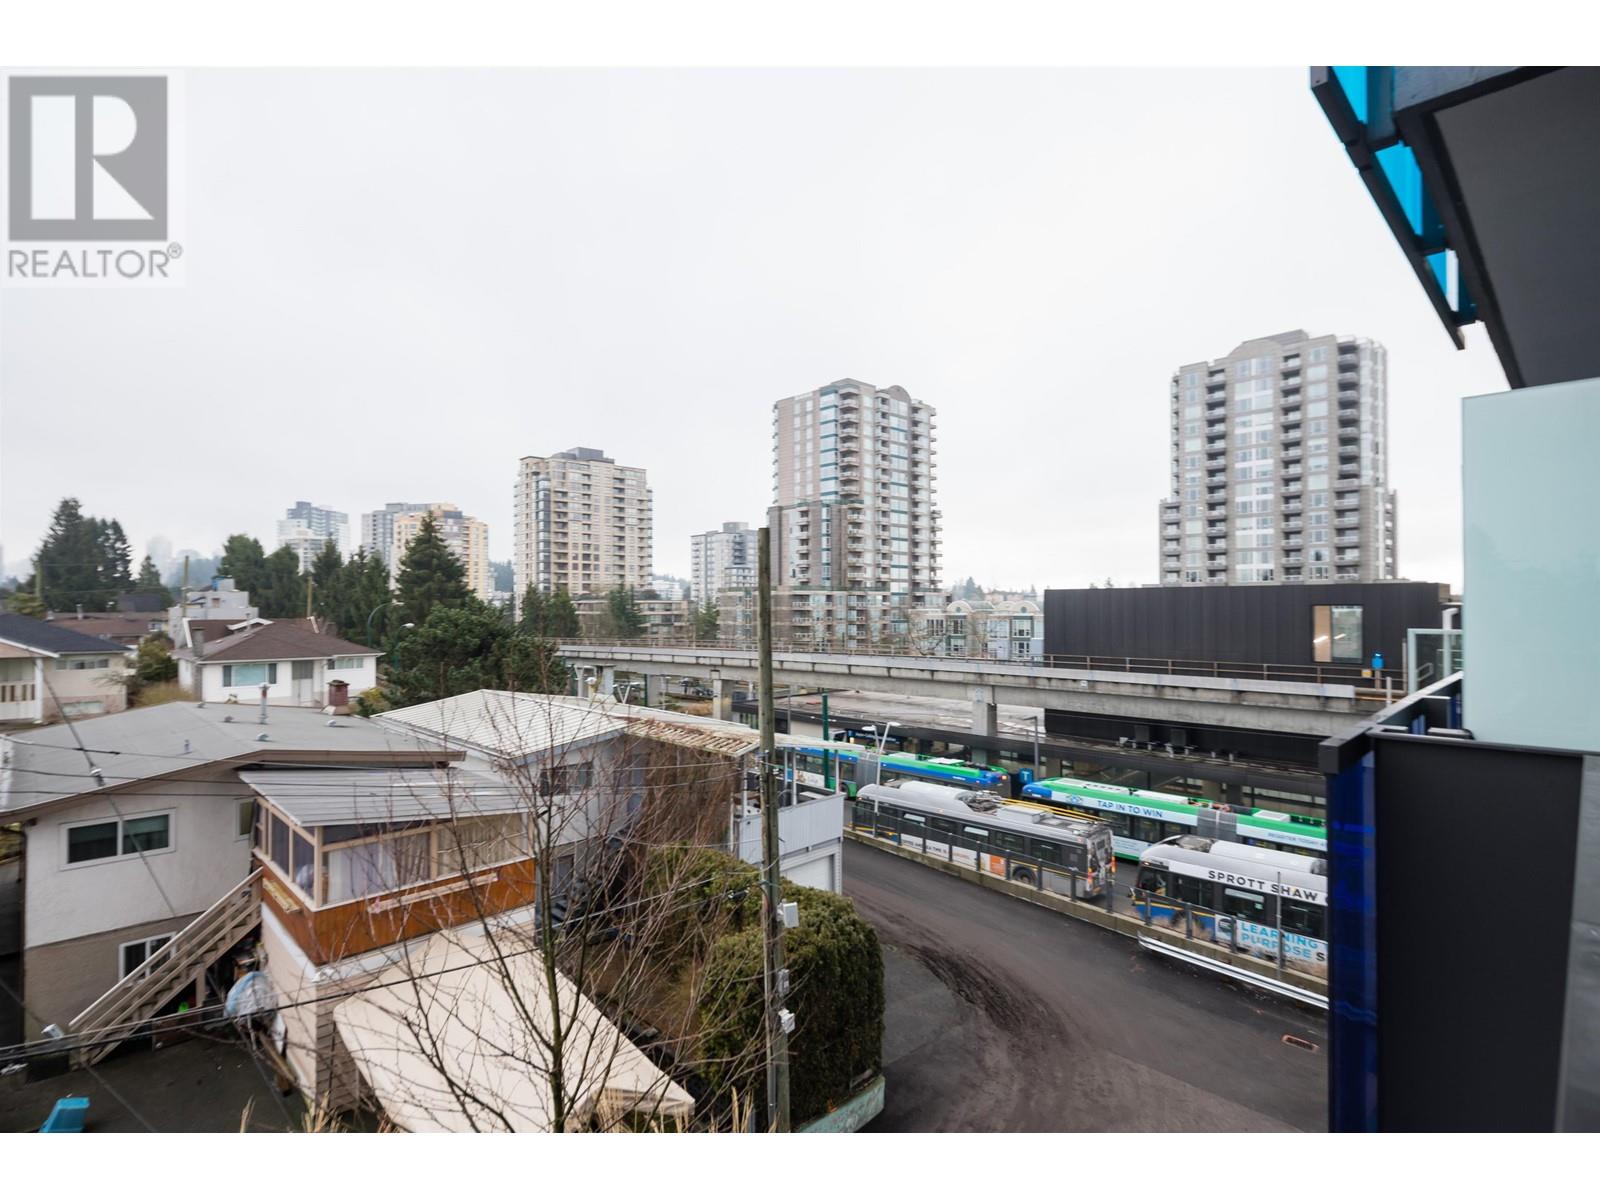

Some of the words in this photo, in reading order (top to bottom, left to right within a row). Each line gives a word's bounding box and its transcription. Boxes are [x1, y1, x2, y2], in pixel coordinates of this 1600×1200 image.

[1097, 800, 1113, 809] TAP
[1115, 803, 1125, 811] IN
[1128, 805, 1140, 814] TO
[1143, 808, 1163, 818] WIN
[1208, 870, 1265, 890] SPROTT
[1271, 883, 1318, 902] SHAW
[1241, 921, 1318, 949] LEARNING
[1241, 933, 1312, 958] PURPOSE
